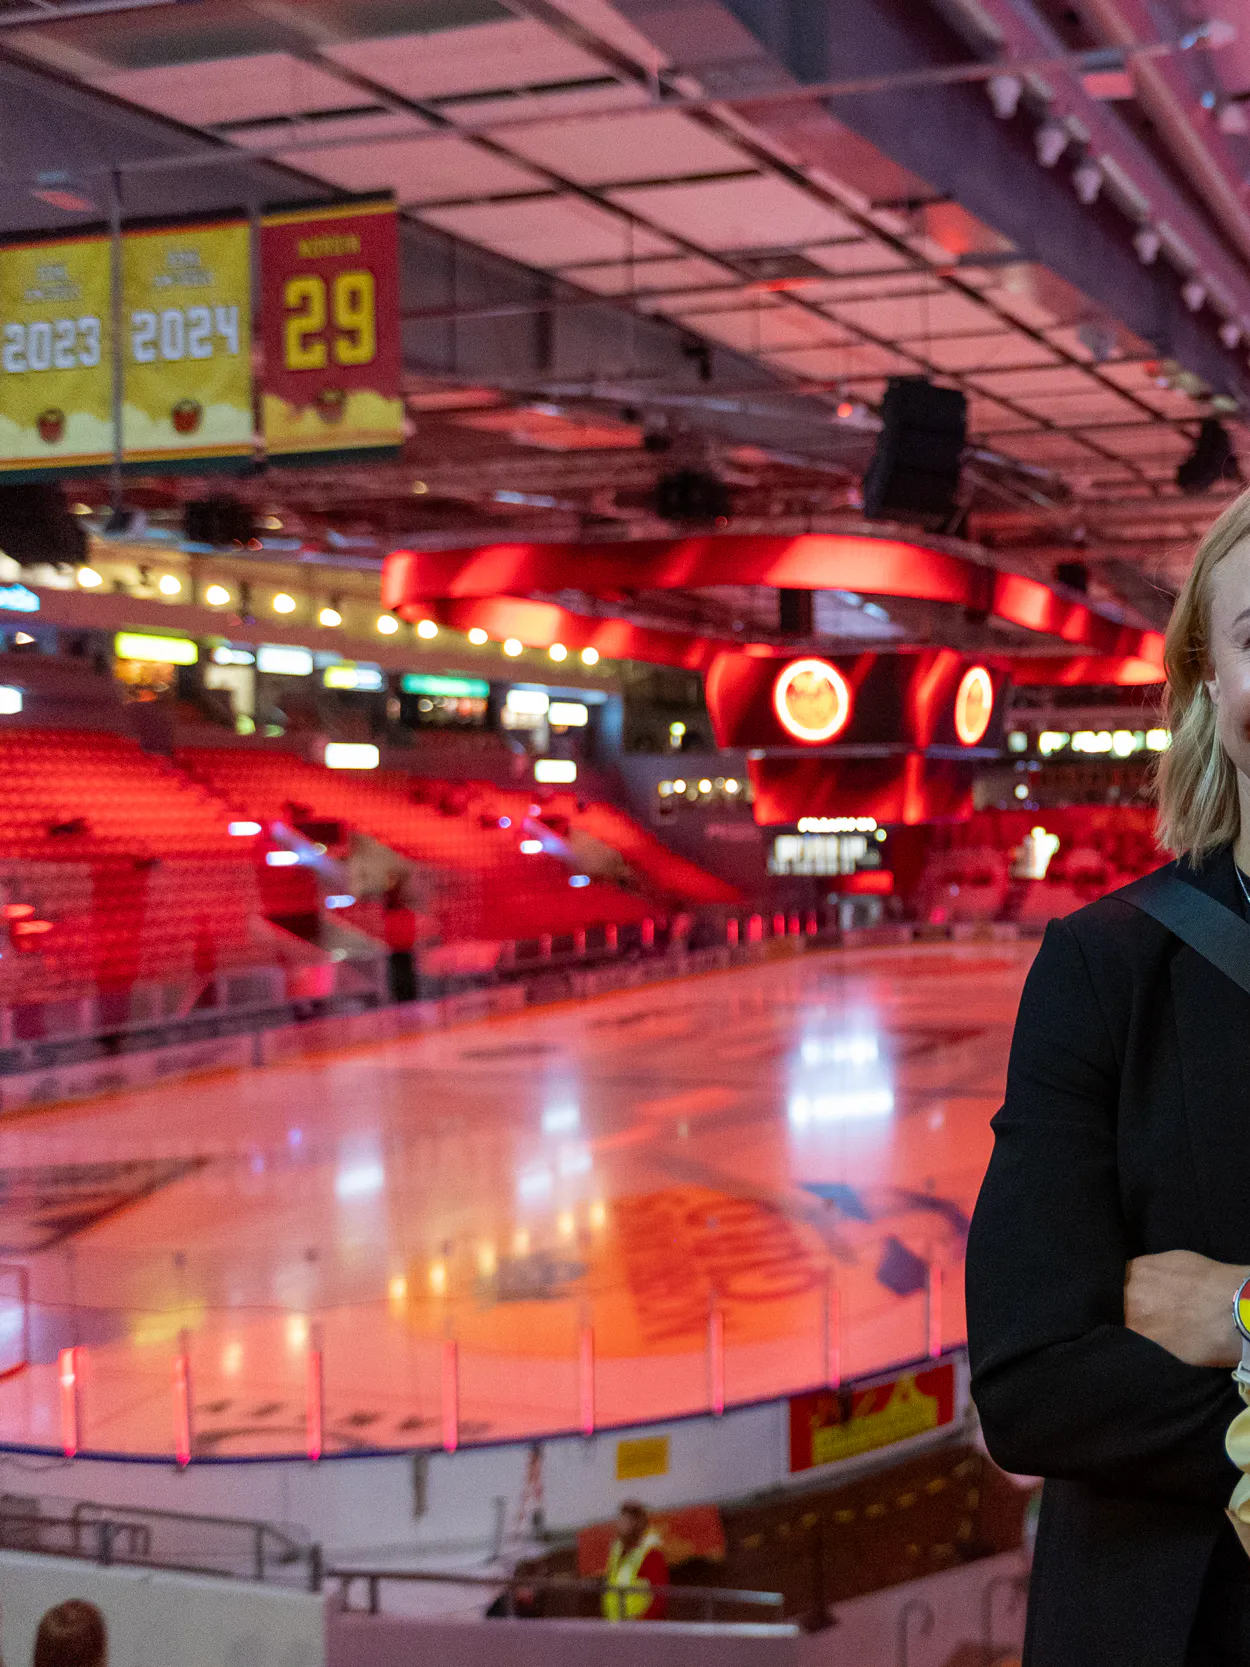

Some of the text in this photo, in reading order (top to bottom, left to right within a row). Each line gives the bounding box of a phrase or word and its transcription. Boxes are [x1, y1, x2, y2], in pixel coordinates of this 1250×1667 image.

[1, 316, 101, 373] 2023
[131, 305, 240, 363] 2024
[284, 270, 375, 369] 29
